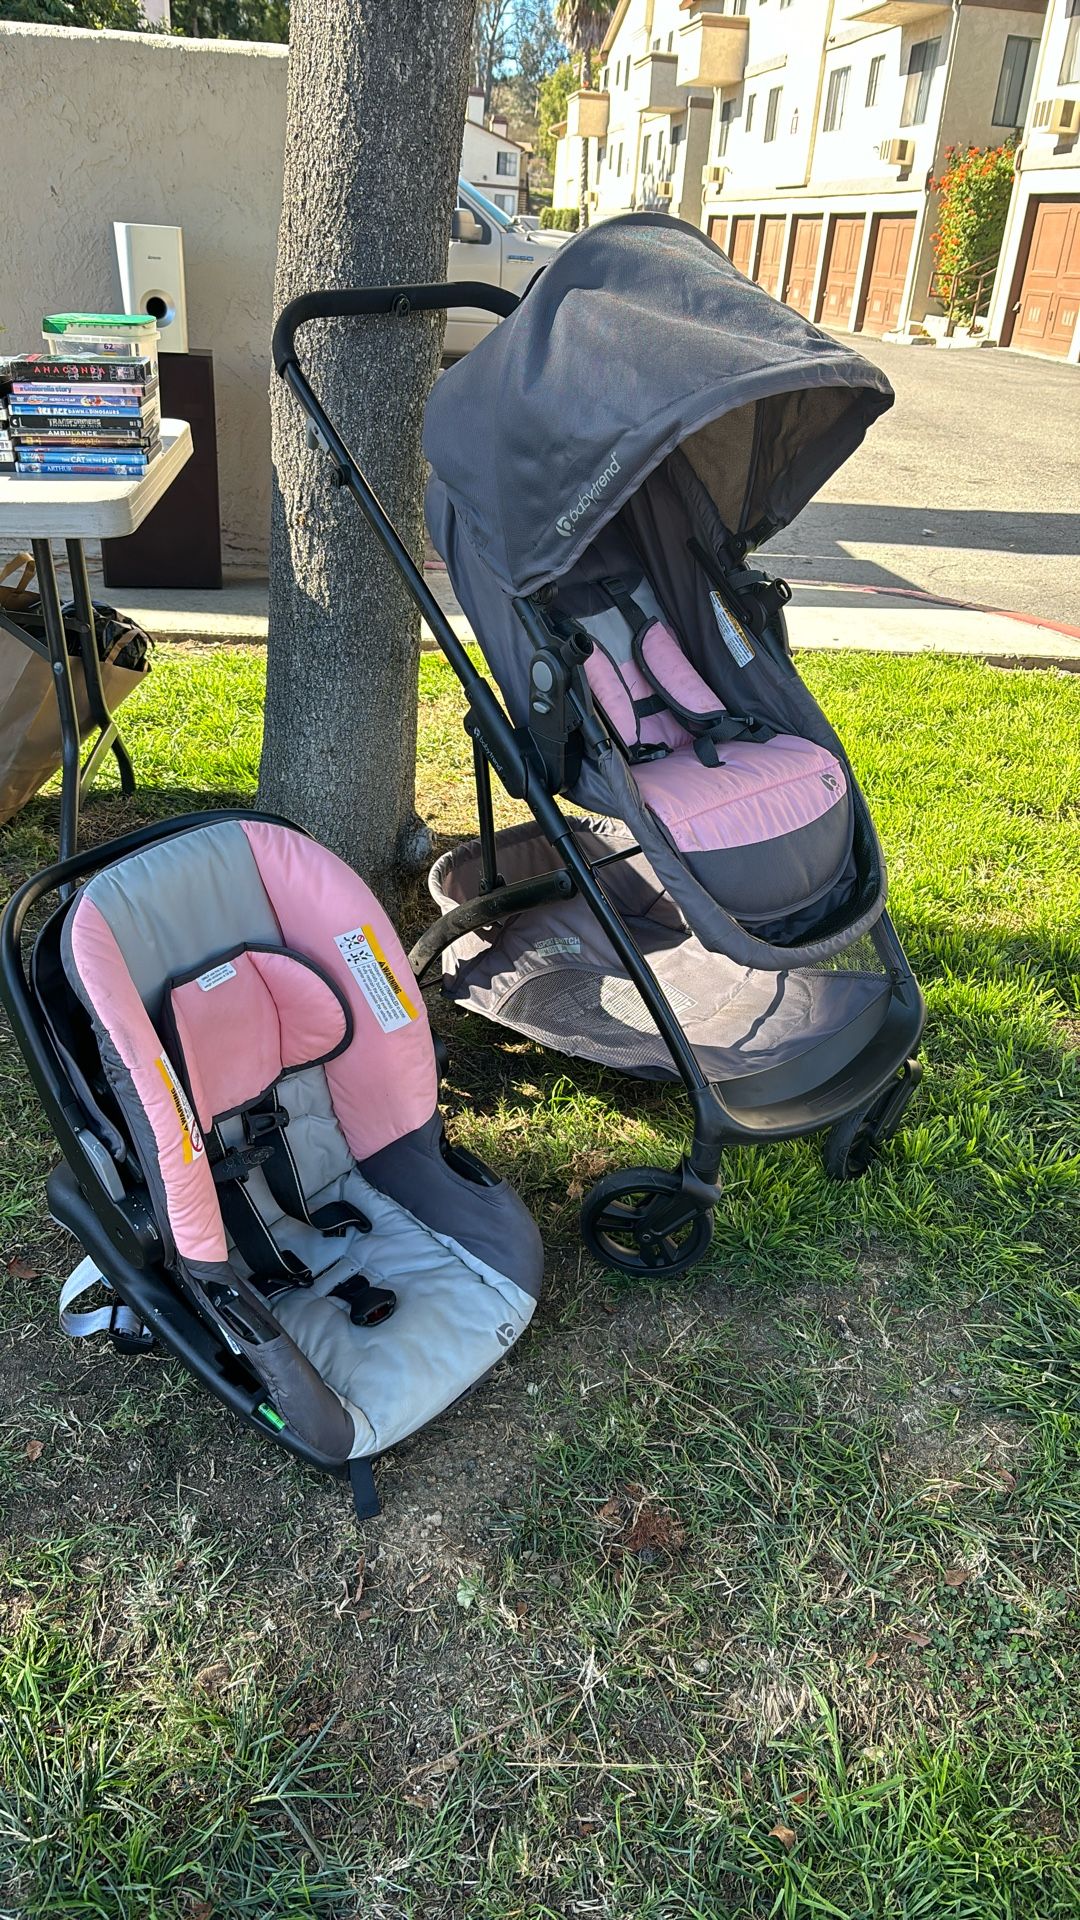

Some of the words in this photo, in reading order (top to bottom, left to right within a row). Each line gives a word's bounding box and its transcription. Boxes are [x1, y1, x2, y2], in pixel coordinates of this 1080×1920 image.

[33, 366, 106, 375] ANACONDA
[382, 965, 402, 995] WARNING
[171, 1088, 188, 1125] WARNING
